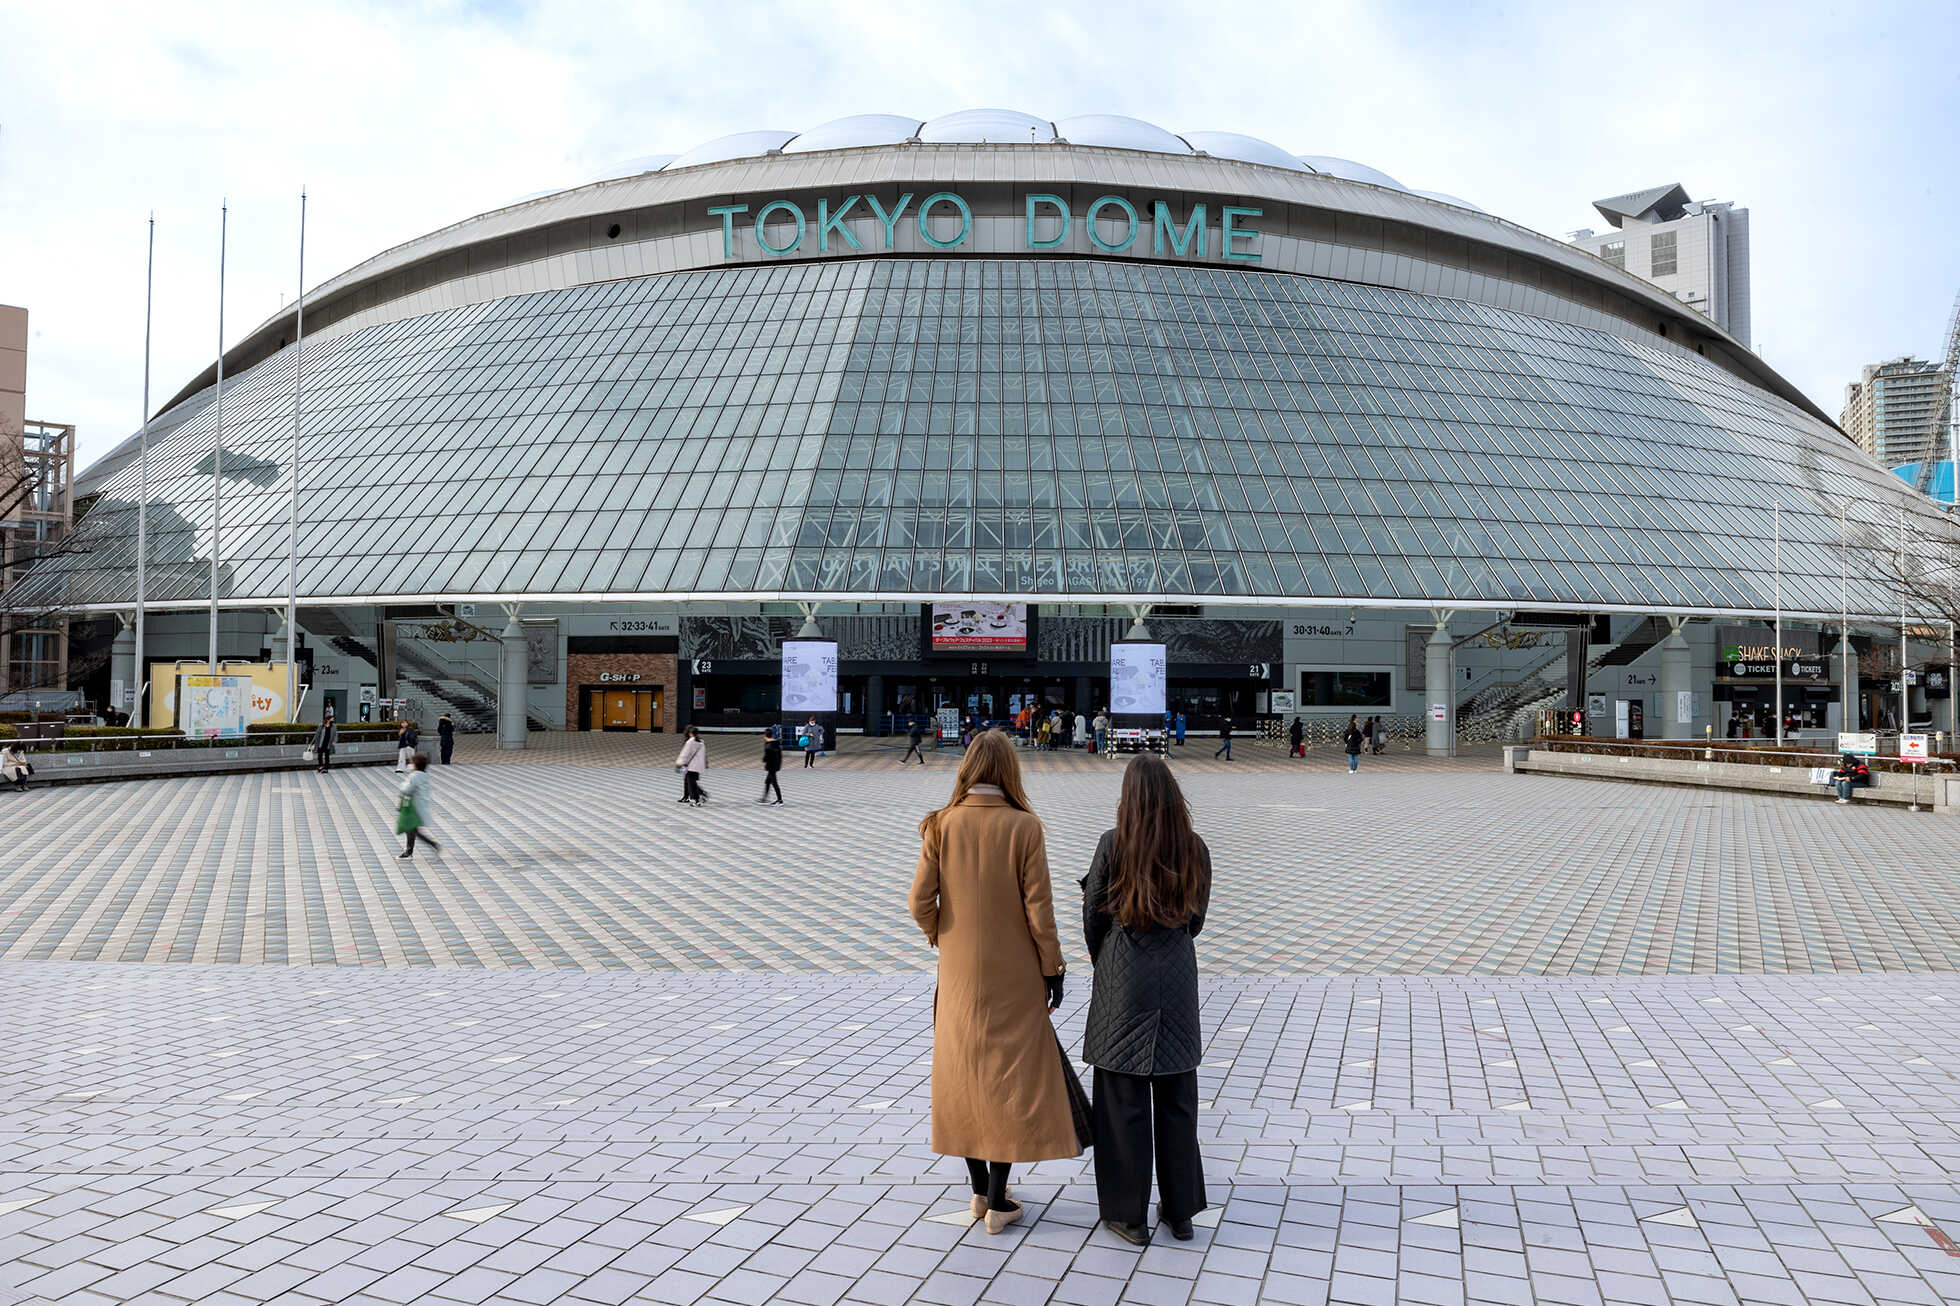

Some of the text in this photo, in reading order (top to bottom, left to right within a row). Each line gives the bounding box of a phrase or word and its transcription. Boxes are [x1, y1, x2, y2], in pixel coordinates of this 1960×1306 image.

[707, 192, 1263, 262] TOKYO DOME
[1738, 645, 1769, 662] SHAKE
[701, 661, 712, 669] 23
[1249, 665, 1259, 673] 21
[1747, 665, 1777, 673] TICKET
[1801, 665, 1822, 673] TICKETS
[321, 665, 330, 674] 23
[1628, 674, 1636, 684] 21
